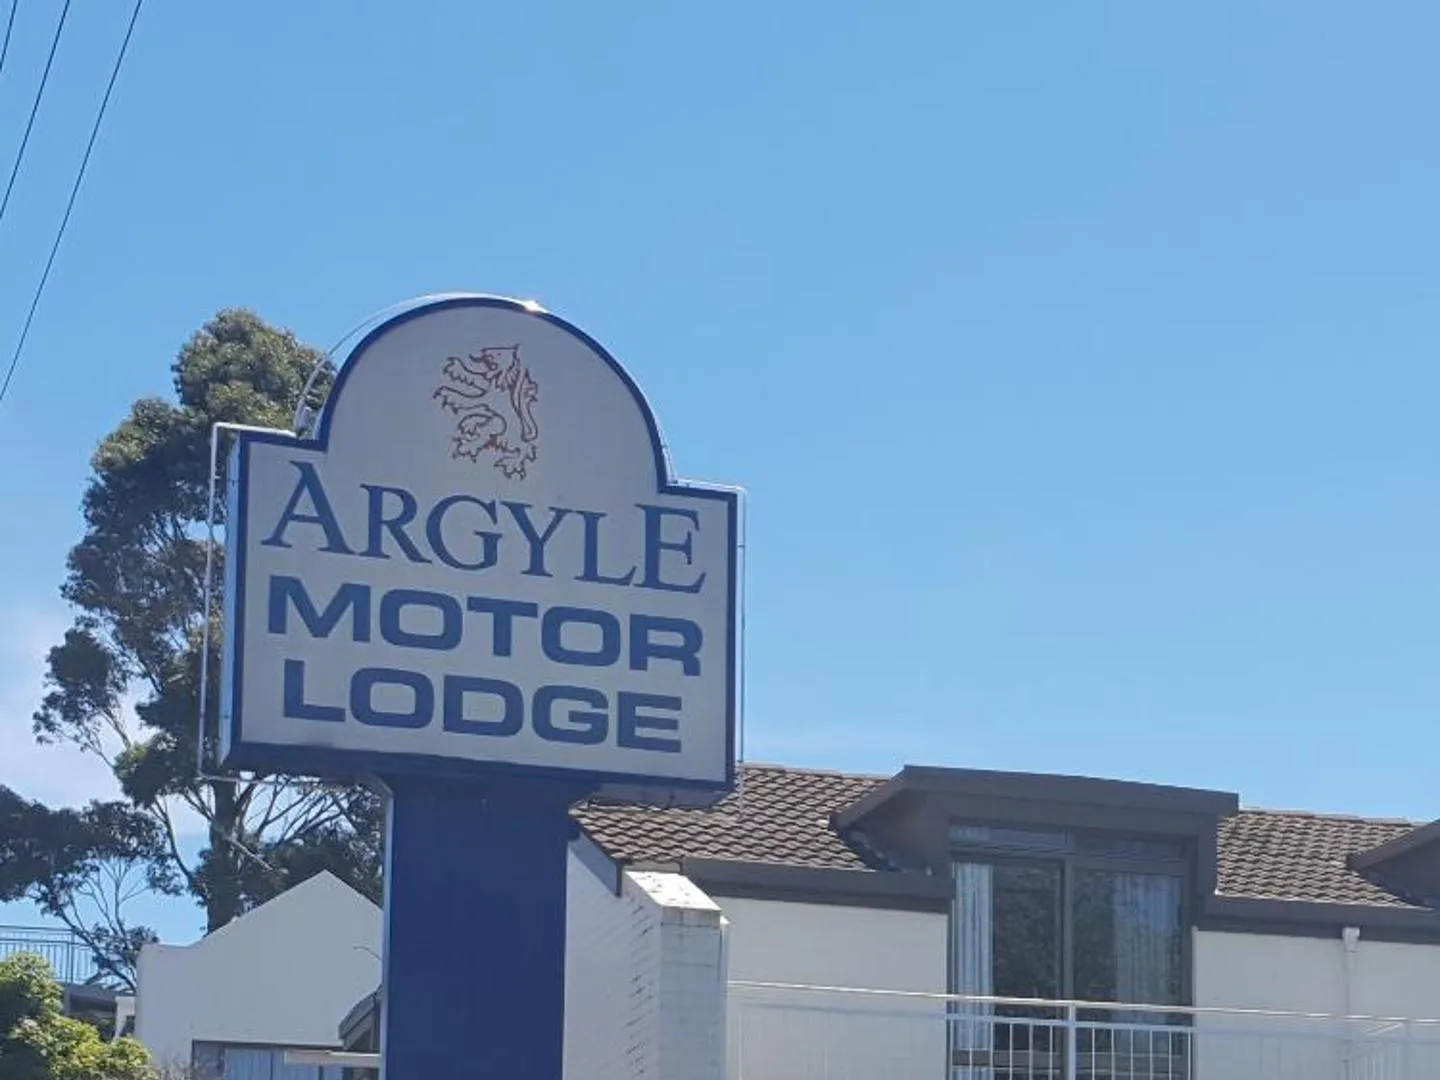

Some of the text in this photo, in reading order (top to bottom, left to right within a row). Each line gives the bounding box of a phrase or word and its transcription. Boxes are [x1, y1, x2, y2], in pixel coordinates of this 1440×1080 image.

[260, 460, 706, 594] ARGYLE
[268, 575, 704, 677] MOTOR
[284, 660, 682, 753] LODGE
